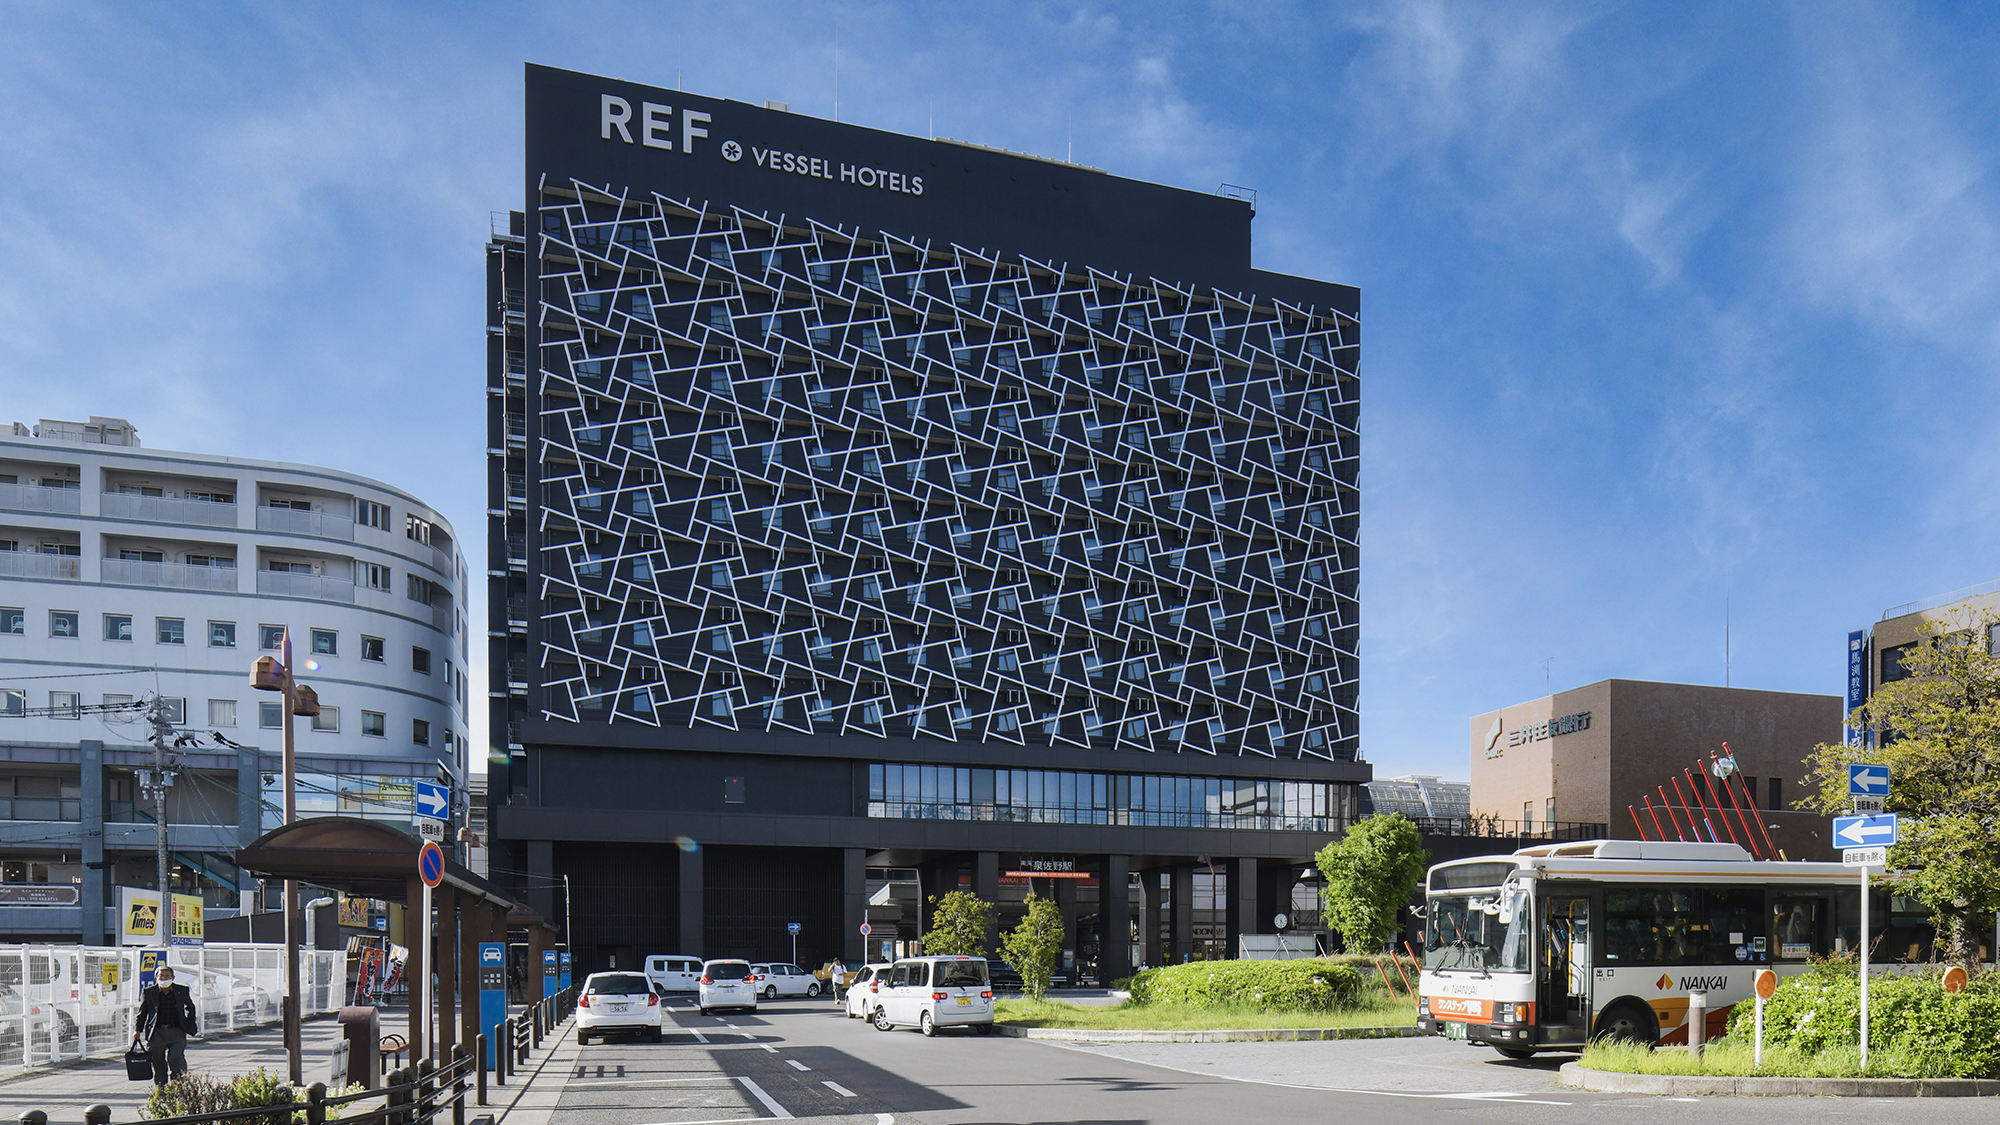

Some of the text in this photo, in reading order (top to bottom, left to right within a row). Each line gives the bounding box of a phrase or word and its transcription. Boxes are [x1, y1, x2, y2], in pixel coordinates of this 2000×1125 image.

[600, 93, 712, 155] REF
[752, 146, 924, 197] VESSEL HOTELS
[1507, 711, 1592, 747] 三井住友銀行
[1856, 800, 1882, 811] 自転車を除く
[1844, 851, 1884, 863] 自転車を除く
[1033, 860, 1073, 871] 泉佐野駅
[131, 911, 155, 930] Times
[1451, 985, 1479, 995] NANKAI
[1679, 975, 1728, 990] NANKAI
